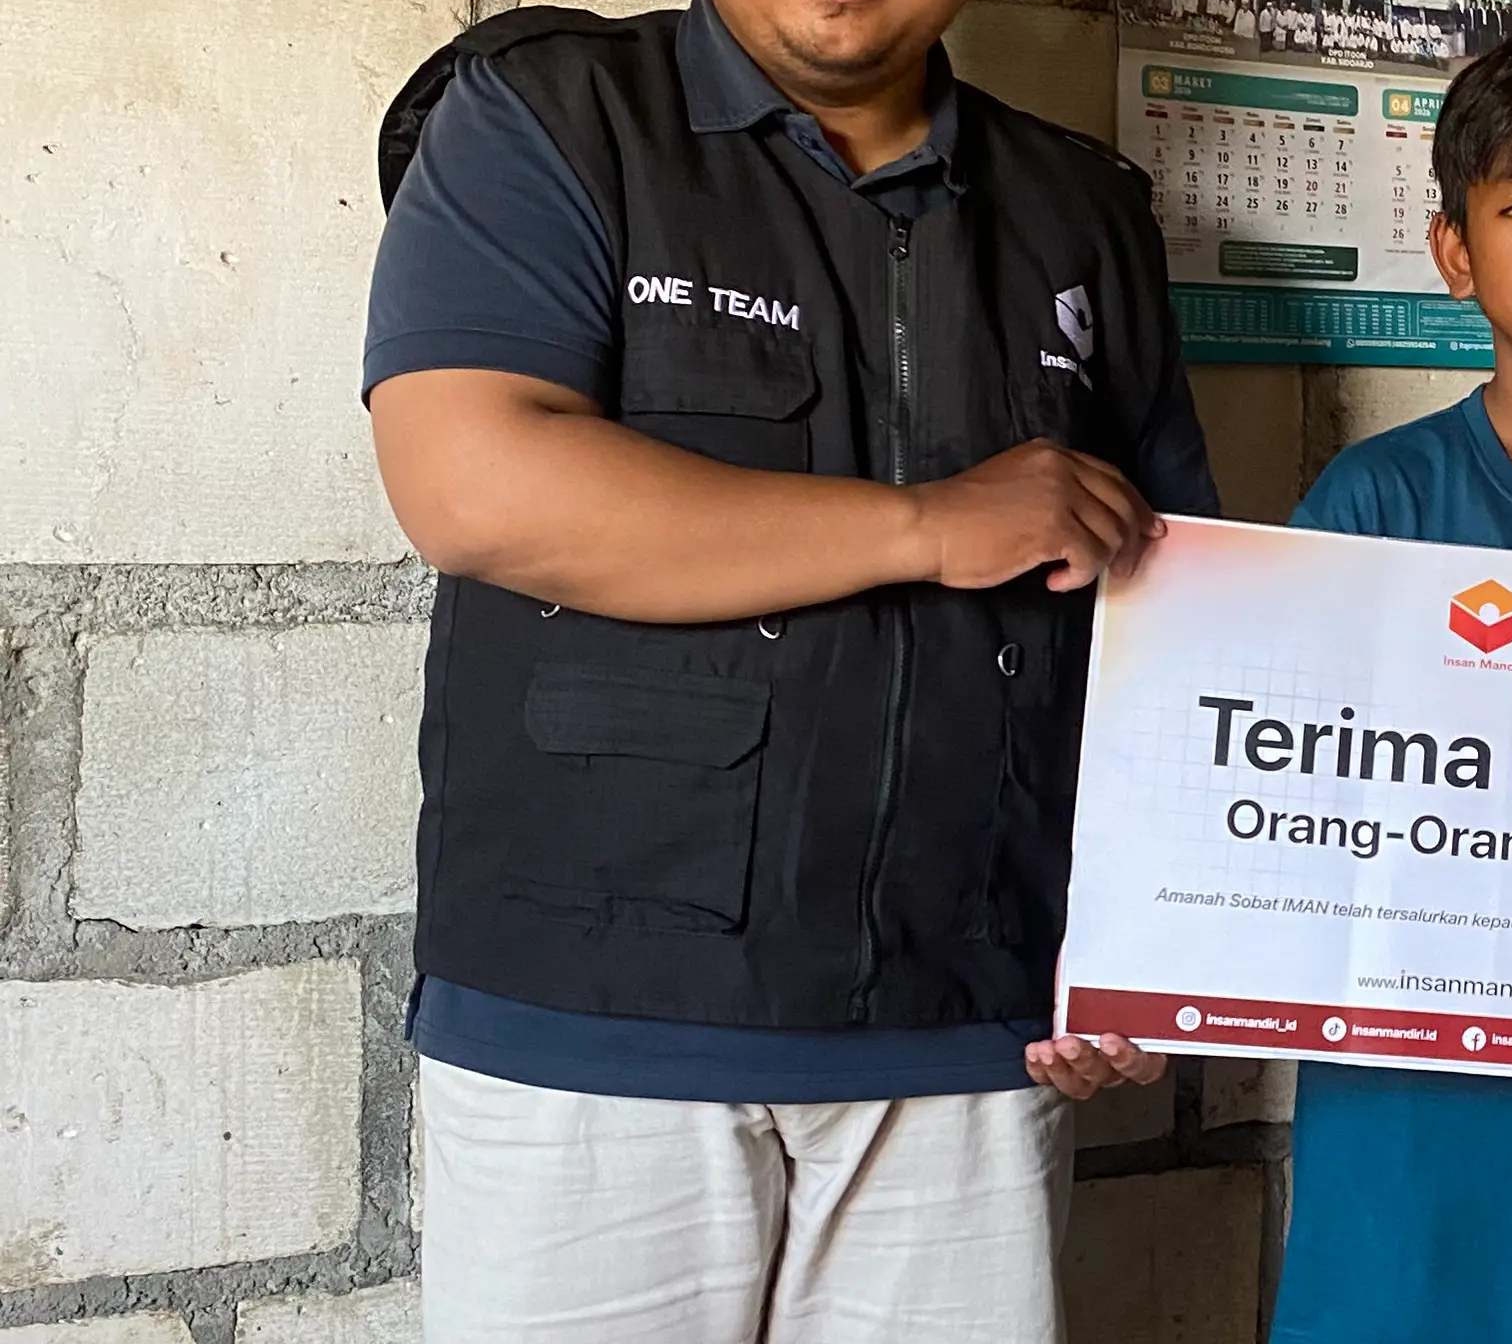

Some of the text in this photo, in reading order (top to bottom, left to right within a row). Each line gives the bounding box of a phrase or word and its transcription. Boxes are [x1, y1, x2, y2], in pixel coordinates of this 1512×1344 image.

[1151, 74, 1169, 89] 03
[1391, 97, 1444, 112] 04 APRI
[1217, 151, 1229, 163] 10
[1247, 154, 1258, 165] 11
[1276, 157, 1288, 168] 12
[1306, 159, 1318, 170] 13
[1335, 161, 1347, 172] 14
[1186, 171, 1198, 183] 16
[1217, 174, 1229, 185] 17
[1247, 176, 1259, 187] 18
[1277, 178, 1289, 189] 19
[1306, 180, 1318, 191] 20
[1335, 182, 1346, 193] 21
[1393, 187, 1437, 199] 12 13
[1184, 193, 1197, 205] 23
[1216, 196, 1229, 207] 24
[1246, 198, 1259, 209] 25
[1276, 199, 1289, 211] 26
[1305, 201, 1318, 213] 27
[1335, 203, 1347, 215] 28
[1393, 208, 1405, 218] 19
[1185, 215, 1198, 226] 30
[1216, 218, 1228, 229] 31
[1392, 228, 1404, 239] 26
[627, 276, 800, 331] ONE TEAM
[1443, 655, 1476, 668] Insan
[1199, 695, 1492, 790] Terima
[1154, 887, 1225, 907] Amanah
[1229, 893, 1278, 911] Sobat
[1282, 898, 1329, 915] IMAN
[1332, 903, 1373, 919] telah
[1376, 907, 1468, 927] tersalurkan
[1206, 1012, 1297, 1032] insanmandiri_id
[1352, 1023, 1438, 1041] insanmandiri.id
